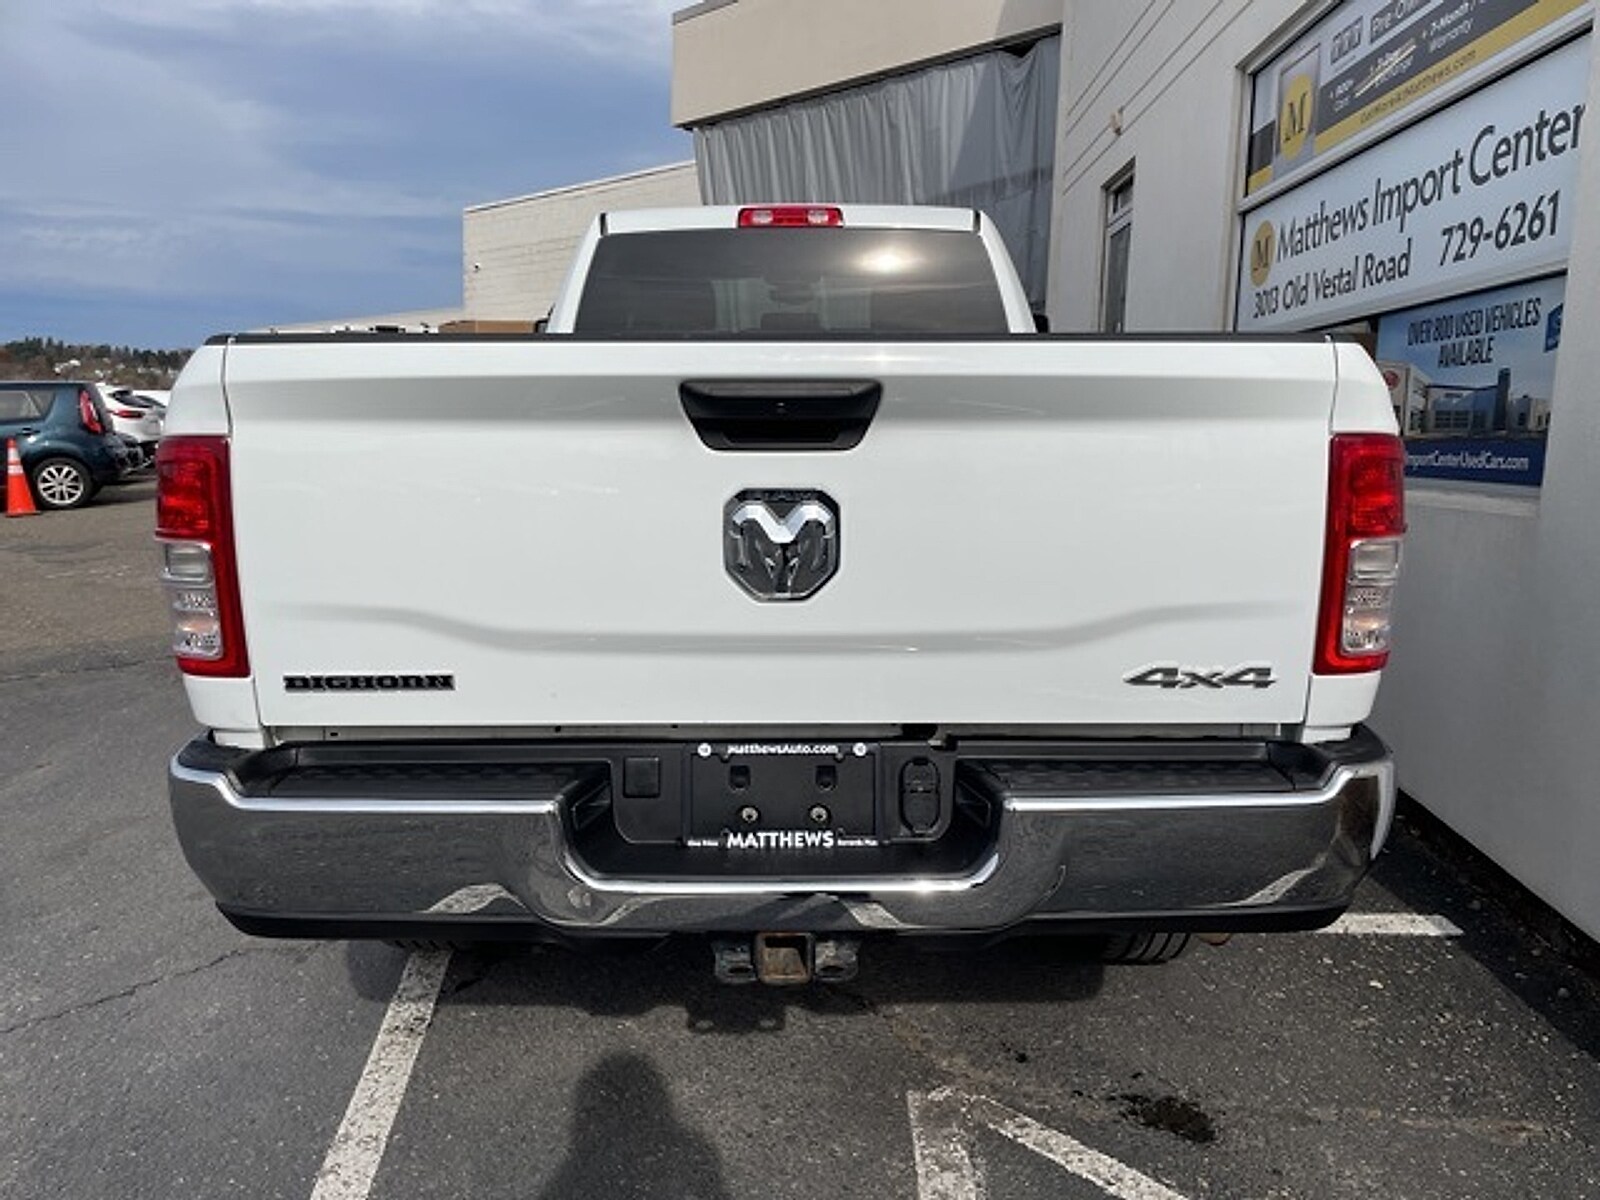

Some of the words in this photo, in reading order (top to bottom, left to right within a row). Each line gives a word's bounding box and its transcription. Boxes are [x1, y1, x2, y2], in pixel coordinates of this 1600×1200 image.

[1277, 200, 1369, 263] Matthews
[1373, 148, 1464, 233] Import
[1469, 104, 1585, 186] Center
[1439, 189, 1560, 267] 729-6261
[1253, 285, 1279, 319] 3013
[1283, 272, 1310, 311] Old
[1313, 255, 1359, 301] Vestal
[1363, 237, 1412, 289] Road
[1407, 318, 1432, 346] OVER
[1433, 314, 1453, 342] 800
[1455, 309, 1483, 339] USED
[1485, 297, 1541, 334] VEHICLES
[1437, 336, 1495, 369] AVAILABLE
[1123, 667, 1277, 689] 4x4
[726, 830, 834, 849] MATTHEWS
